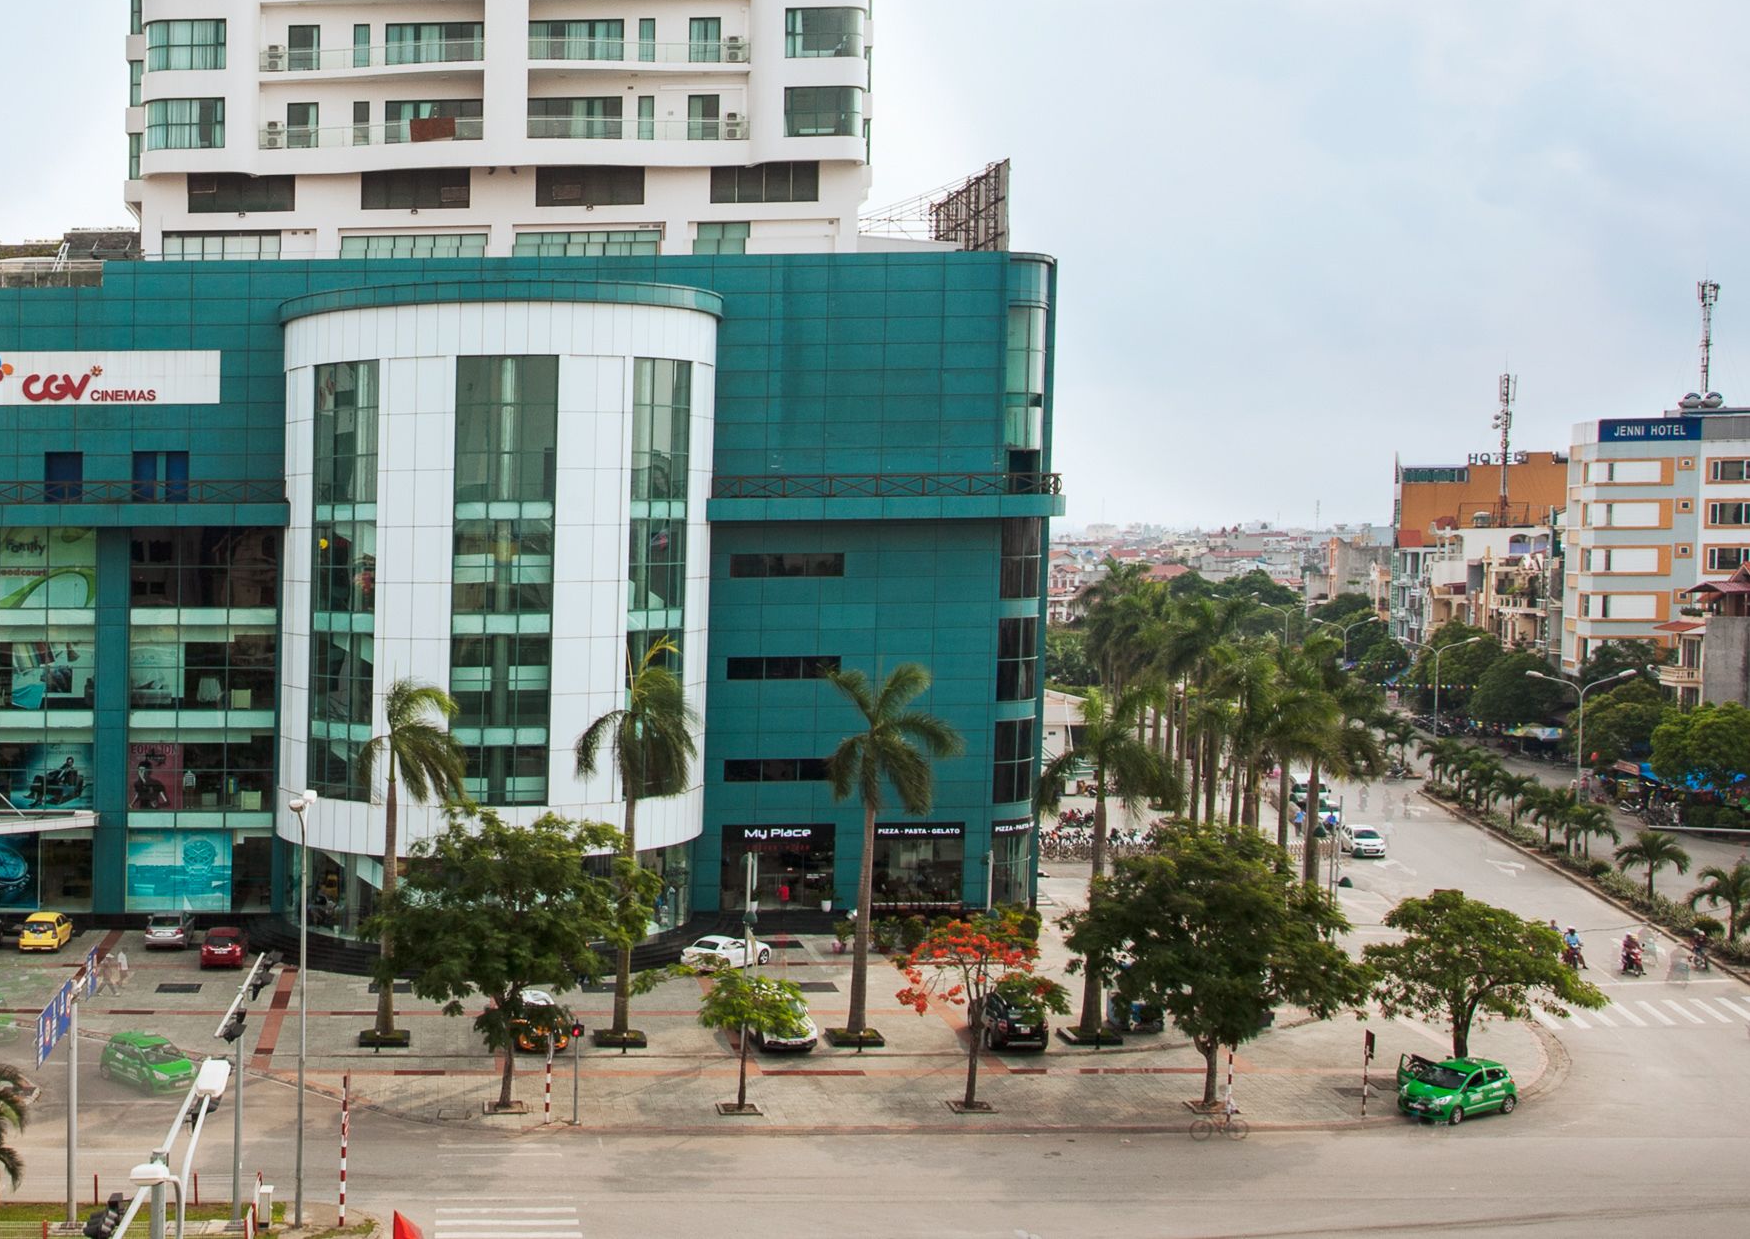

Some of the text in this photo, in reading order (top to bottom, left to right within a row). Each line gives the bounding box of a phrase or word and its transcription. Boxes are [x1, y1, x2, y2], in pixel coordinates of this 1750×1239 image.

[22, 373, 156, 402] CGV CINEMAS
[1614, 425, 1686, 437] JENNI HOTEL
[744, 828, 811, 839] My Place
